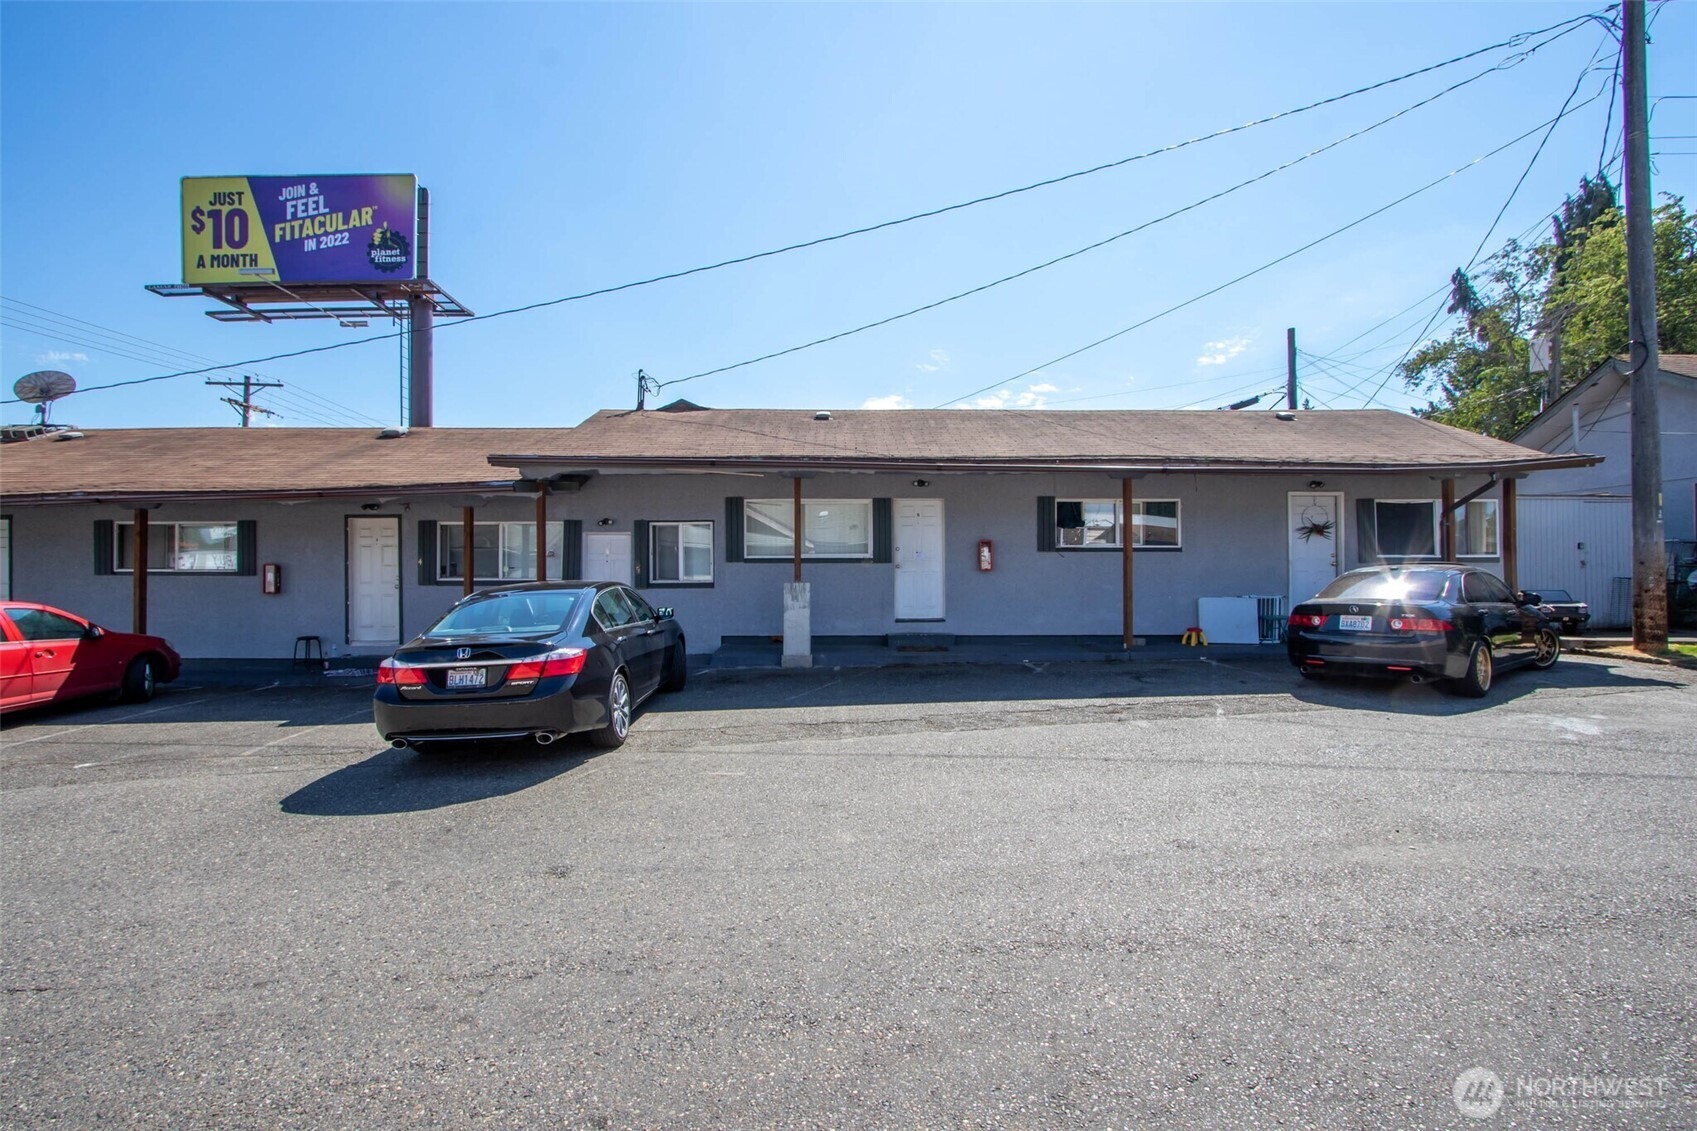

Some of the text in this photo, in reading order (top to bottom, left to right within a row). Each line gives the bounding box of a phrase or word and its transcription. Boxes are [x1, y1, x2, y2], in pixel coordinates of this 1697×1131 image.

[209, 191, 244, 206] JUST
[278, 182, 319, 201] JOIN &
[286, 195, 329, 220] FEEL
[191, 206, 249, 250] $10
[304, 232, 350, 252] IN 2022
[196, 253, 258, 268] A MONTH
[370, 248, 400, 258] planet
[374, 255, 407, 263] fitness
